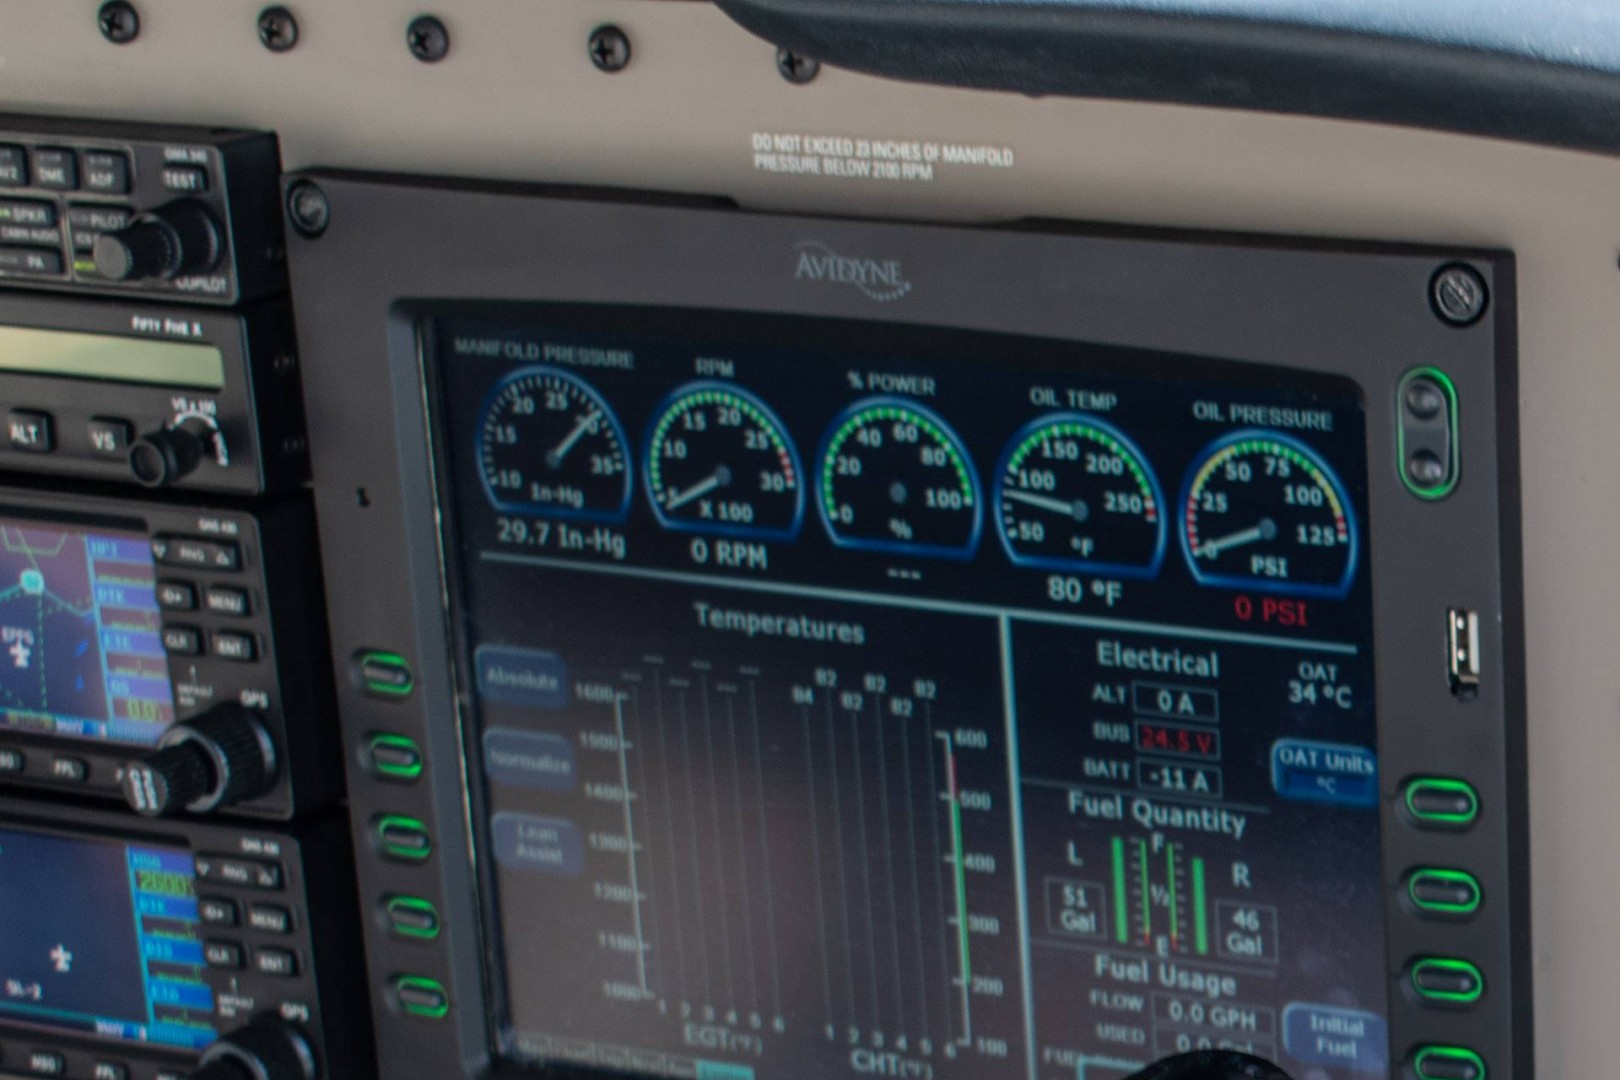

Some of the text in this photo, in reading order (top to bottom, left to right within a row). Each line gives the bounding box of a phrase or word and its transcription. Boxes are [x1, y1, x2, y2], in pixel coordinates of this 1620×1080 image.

[752, 132, 773, 151] DO
[774, 134, 801, 153] NOT
[803, 136, 853, 157] EXCEED
[872, 142, 921, 161] INCHES
[923, 144, 941, 163] OF
[943, 146, 1014, 167] MANIFOLD
[754, 153, 821, 175] PRESSURE
[823, 158, 871, 178] BELOW
[902, 163, 933, 181] RPM
[164, 172, 196, 189] TEST
[795, 253, 901, 286] AVIDYNE
[454, 338, 634, 370] MANIFOLD PRESSURE
[695, 358, 734, 378] RPM
[869, 373, 936, 396] POWER
[1029, 386, 1117, 412] OIL TEMP
[683, 413, 706, 432] 15
[718, 408, 741, 427] 20
[1192, 402, 1334, 432] OIL PRESSURE
[10, 421, 38, 445] ALT
[92, 431, 116, 451] VS
[745, 430, 768, 450] 25
[663, 441, 687, 459] 10
[1041, 440, 1079, 460] 150
[1085, 455, 1124, 476] 200
[1225, 461, 1251, 483] 50
[1264, 457, 1290, 478] 75
[760, 472, 784, 492] 30
[1018, 470, 1055, 491] 100
[1104, 493, 1142, 513] 250
[1203, 493, 1228, 513] 25
[1284, 486, 1322, 507] 100
[719, 503, 753, 523] 100
[498, 519, 627, 560] 29.7 In-Hg
[1019, 522, 1045, 542] 50
[1297, 526, 1335, 547] 125
[715, 541, 768, 570] RPM
[1251, 555, 1288, 578] PSI
[1047, 577, 1082, 602] 80
[207, 593, 243, 613] MENU
[1235, 597, 1308, 627] 0 PSI
[694, 602, 865, 644] Temperatures
[1096, 639, 1220, 678] Electrical
[487, 666, 558, 691] Absolute
[1299, 662, 1338, 682] OAT
[1092, 684, 1128, 705] ALT
[1178, 692, 1195, 715] A
[1289, 680, 1316, 705] 34
[1093, 722, 1130, 744] BUS
[1197, 733, 1212, 754] V
[490, 750, 571, 775] Normalize
[1279, 748, 1374, 775] OAT Units
[1083, 758, 1210, 793] BATT -11 A
[1068, 791, 1246, 840] Fuel Quantity
[1067, 841, 1084, 866] L
[1232, 862, 1251, 887] R
[1060, 910, 1096, 933] Gal
[1233, 908, 1260, 932] 46
[1227, 932, 1263, 956] Gal
[1095, 955, 1236, 997] Fuel Usage
[1091, 990, 1256, 1031] FLOW 0.0 GPH
[1096, 1023, 1145, 1045] USED
[1310, 1014, 1364, 1037] Initial
[1317, 1038, 1357, 1059] Fuel
